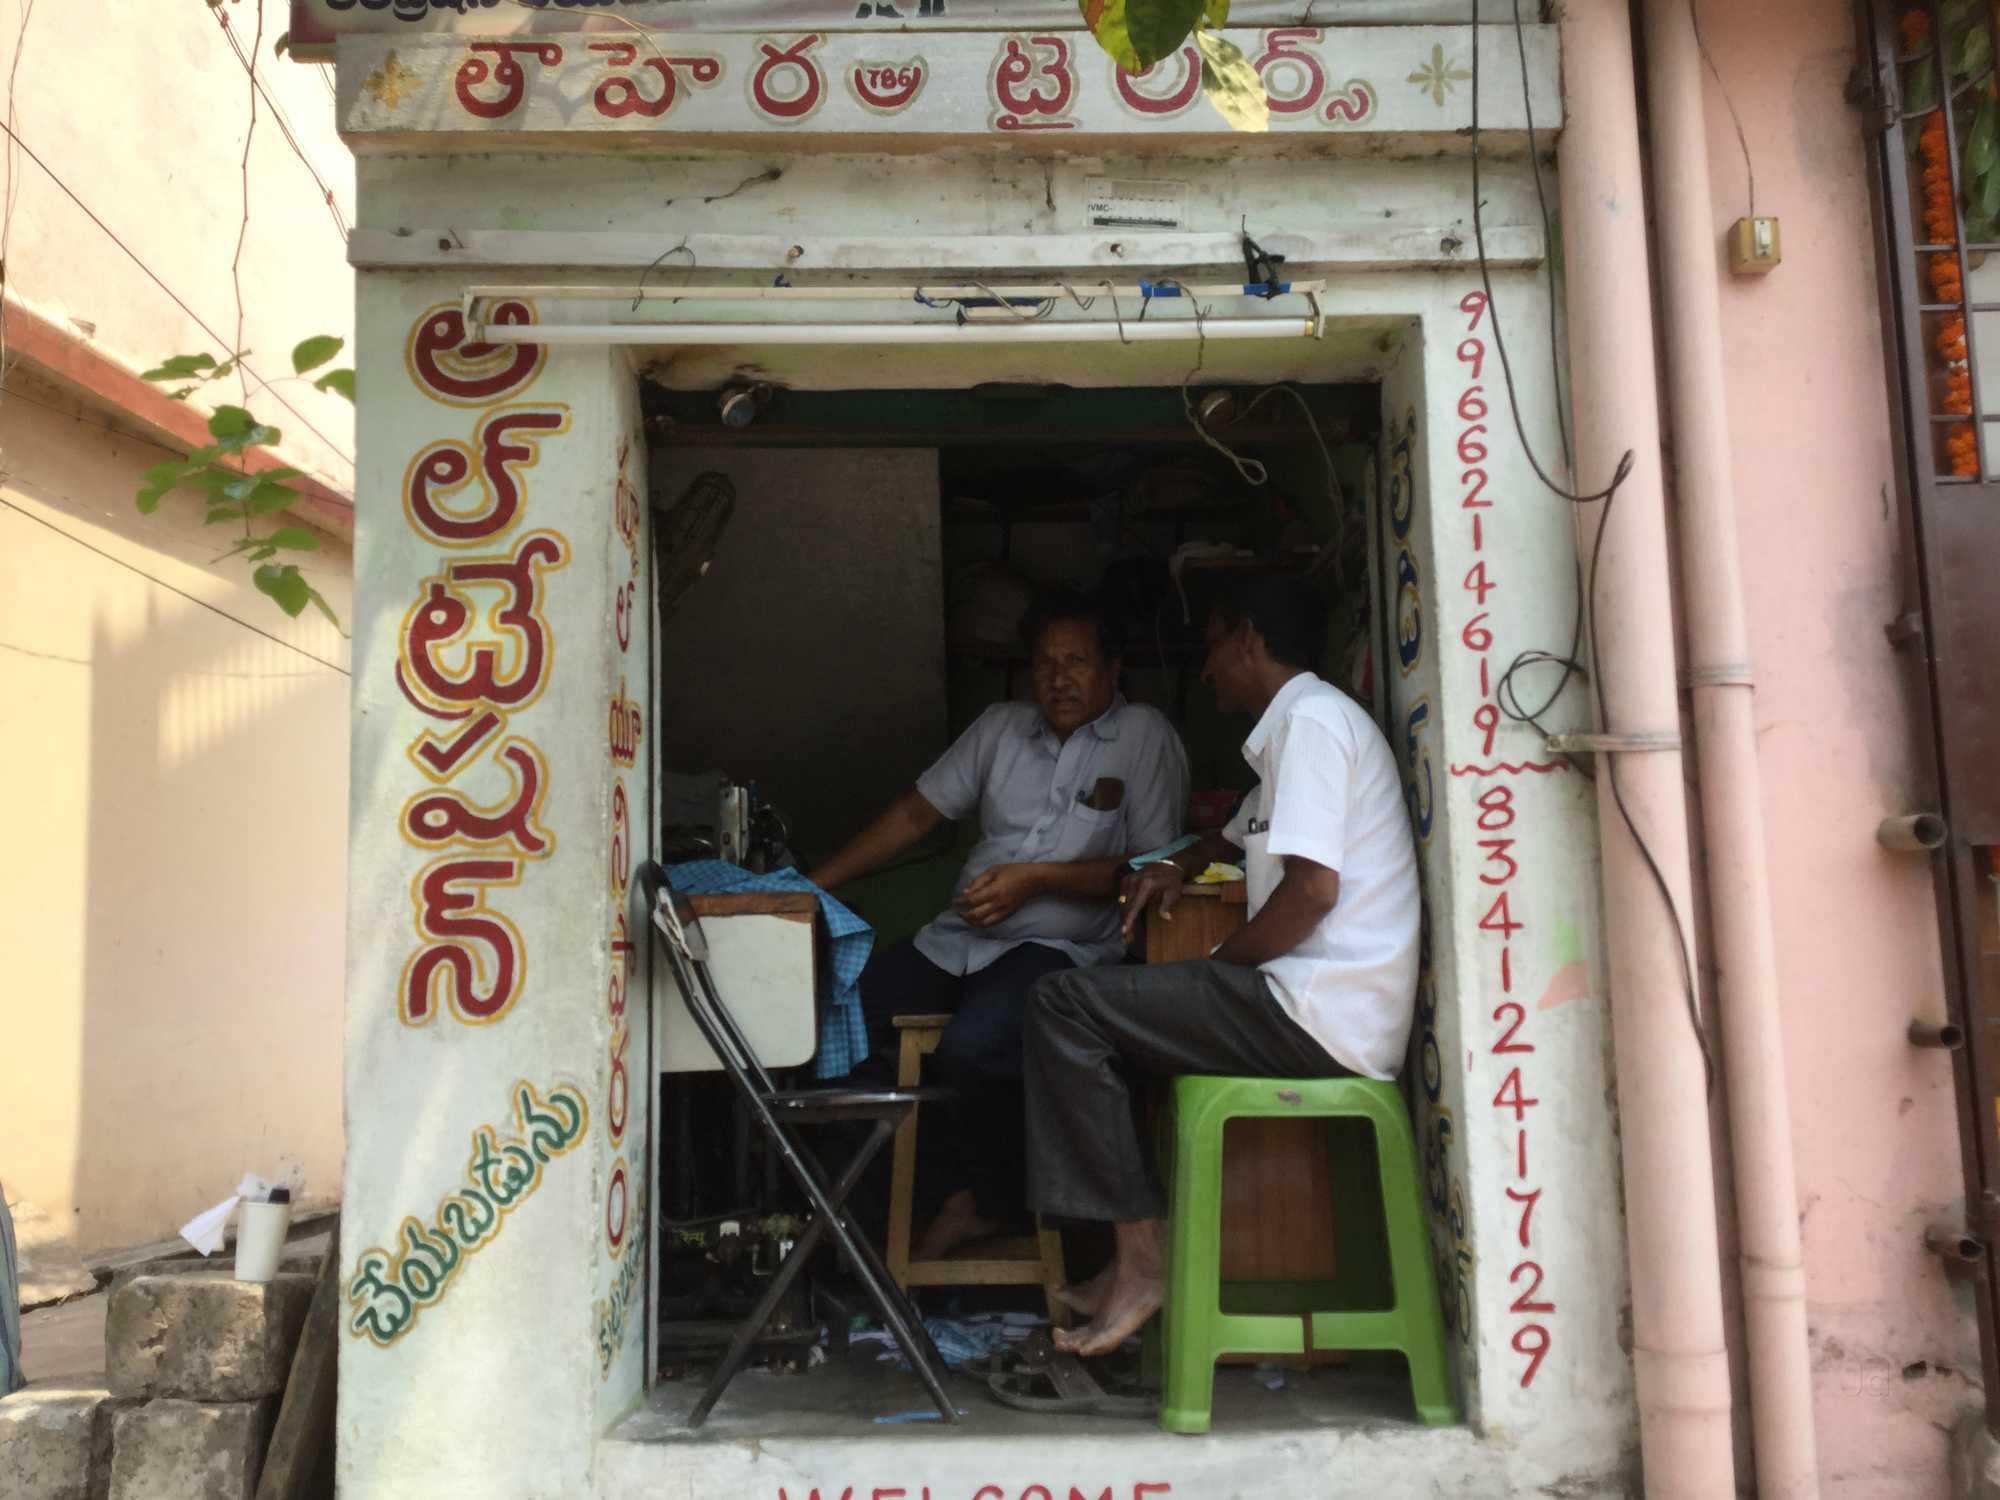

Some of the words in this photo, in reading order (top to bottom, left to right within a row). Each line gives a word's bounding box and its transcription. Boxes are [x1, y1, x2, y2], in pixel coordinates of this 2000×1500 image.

[866, 66, 912, 90] 786
[1456, 290, 1498, 757] 9966214619
[1476, 785, 1556, 1389] 8341241729
